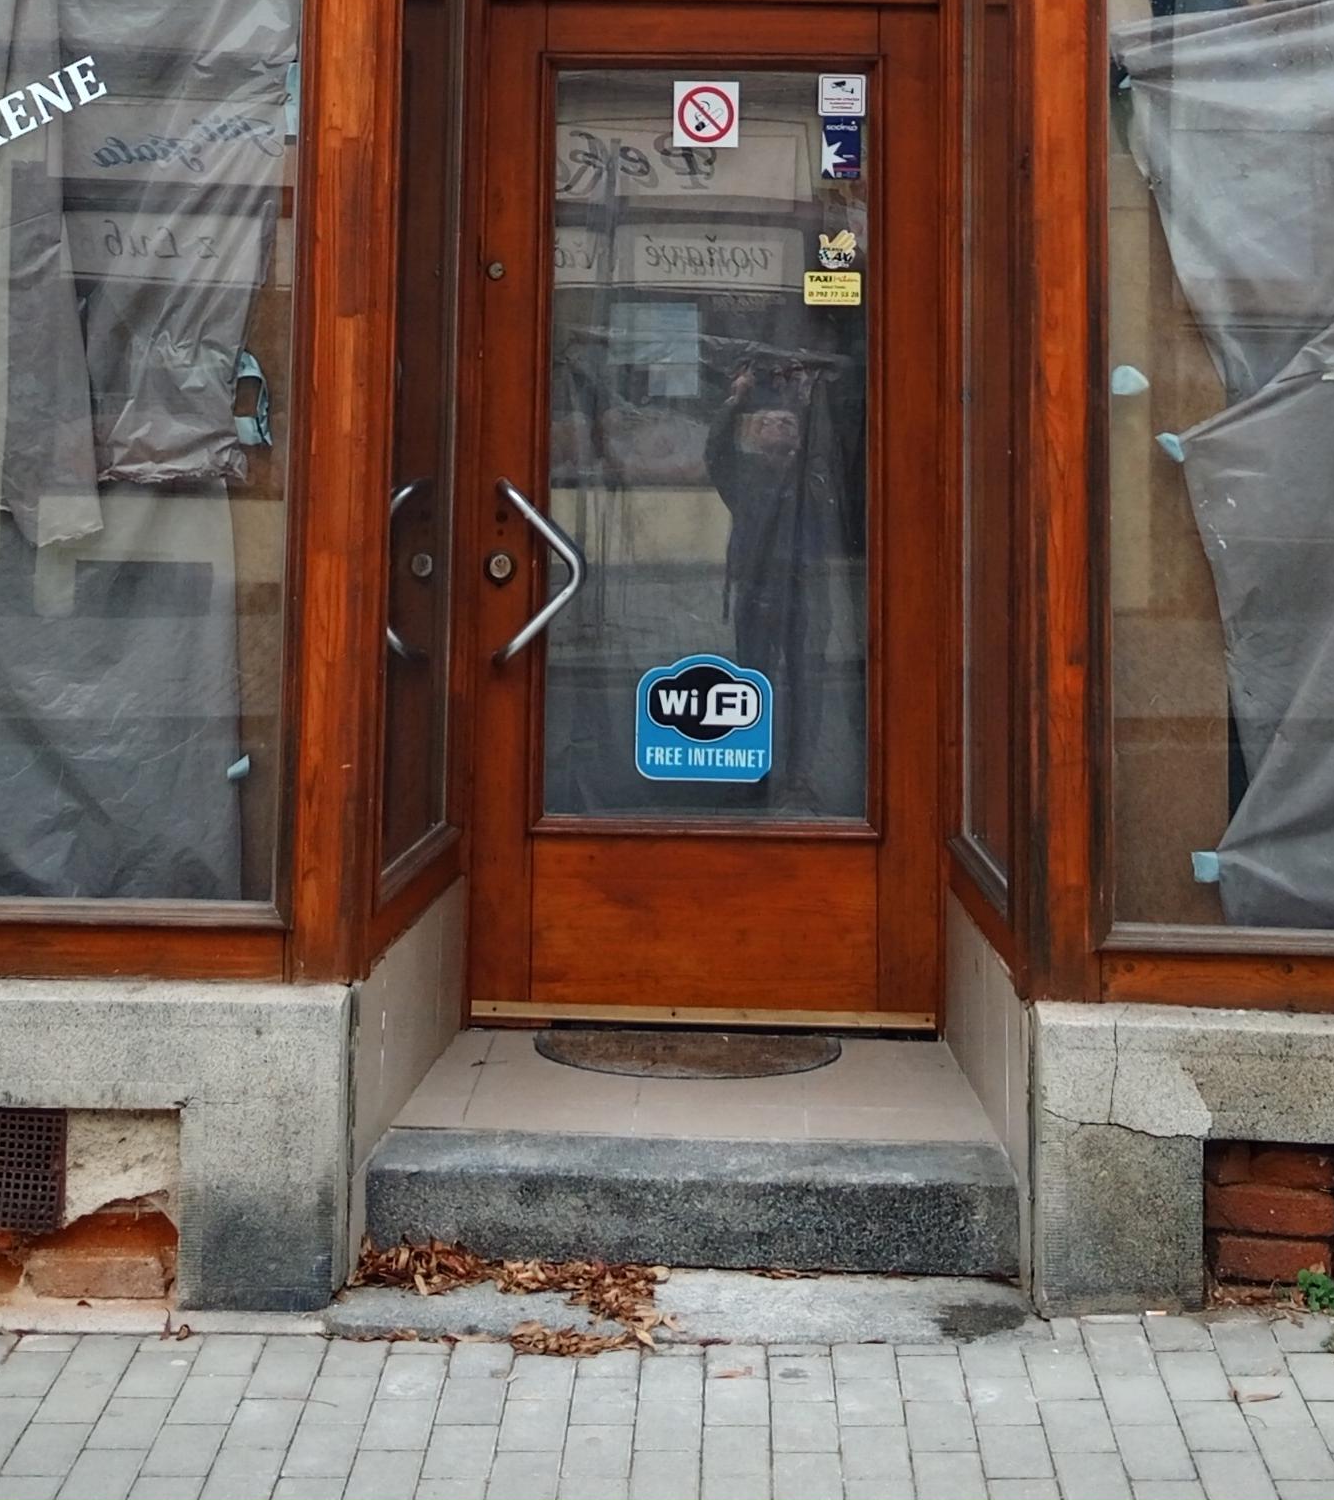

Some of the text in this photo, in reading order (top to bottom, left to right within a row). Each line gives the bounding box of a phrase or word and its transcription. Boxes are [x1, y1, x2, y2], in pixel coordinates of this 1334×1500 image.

[809, 275, 832, 283] TAXI
[646, 746, 765, 769] FREE INTERNET
